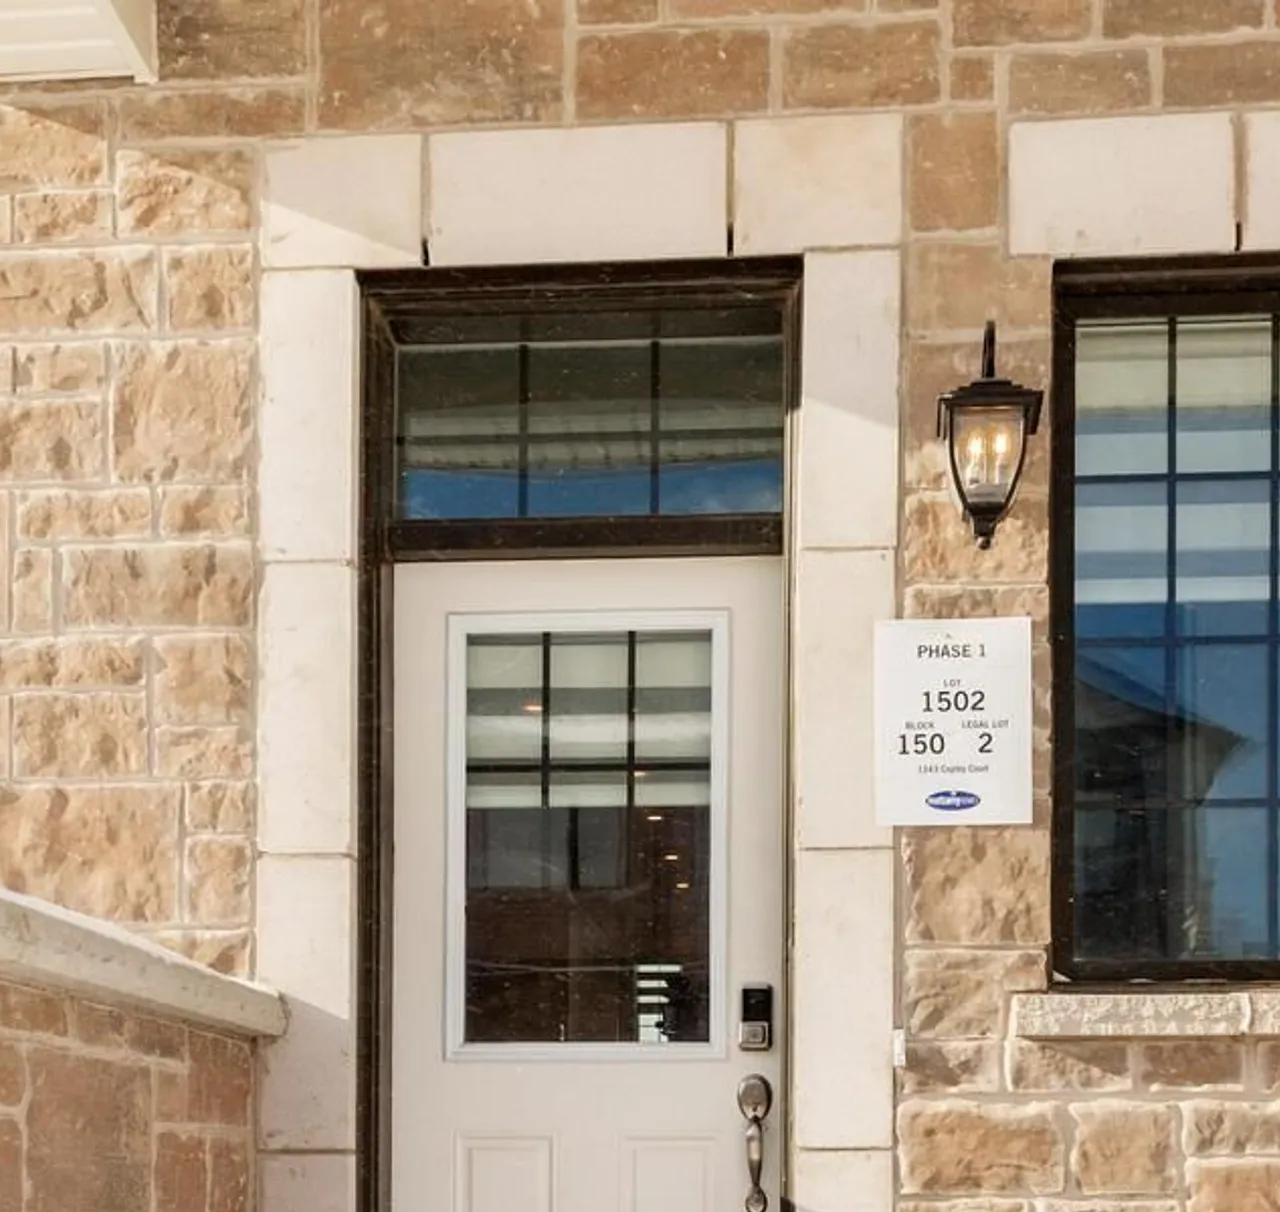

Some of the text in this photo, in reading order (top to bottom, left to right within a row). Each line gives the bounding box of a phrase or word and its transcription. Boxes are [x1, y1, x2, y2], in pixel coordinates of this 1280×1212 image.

[917, 644, 986, 658] PHASE 1
[943, 679, 961, 687] LOT
[922, 691, 985, 713] 1502
[905, 721, 935, 730] BLOCK
[961, 719, 1010, 729] LEGAL LOT
[898, 733, 945, 755] 150
[978, 732, 993, 753] 2
